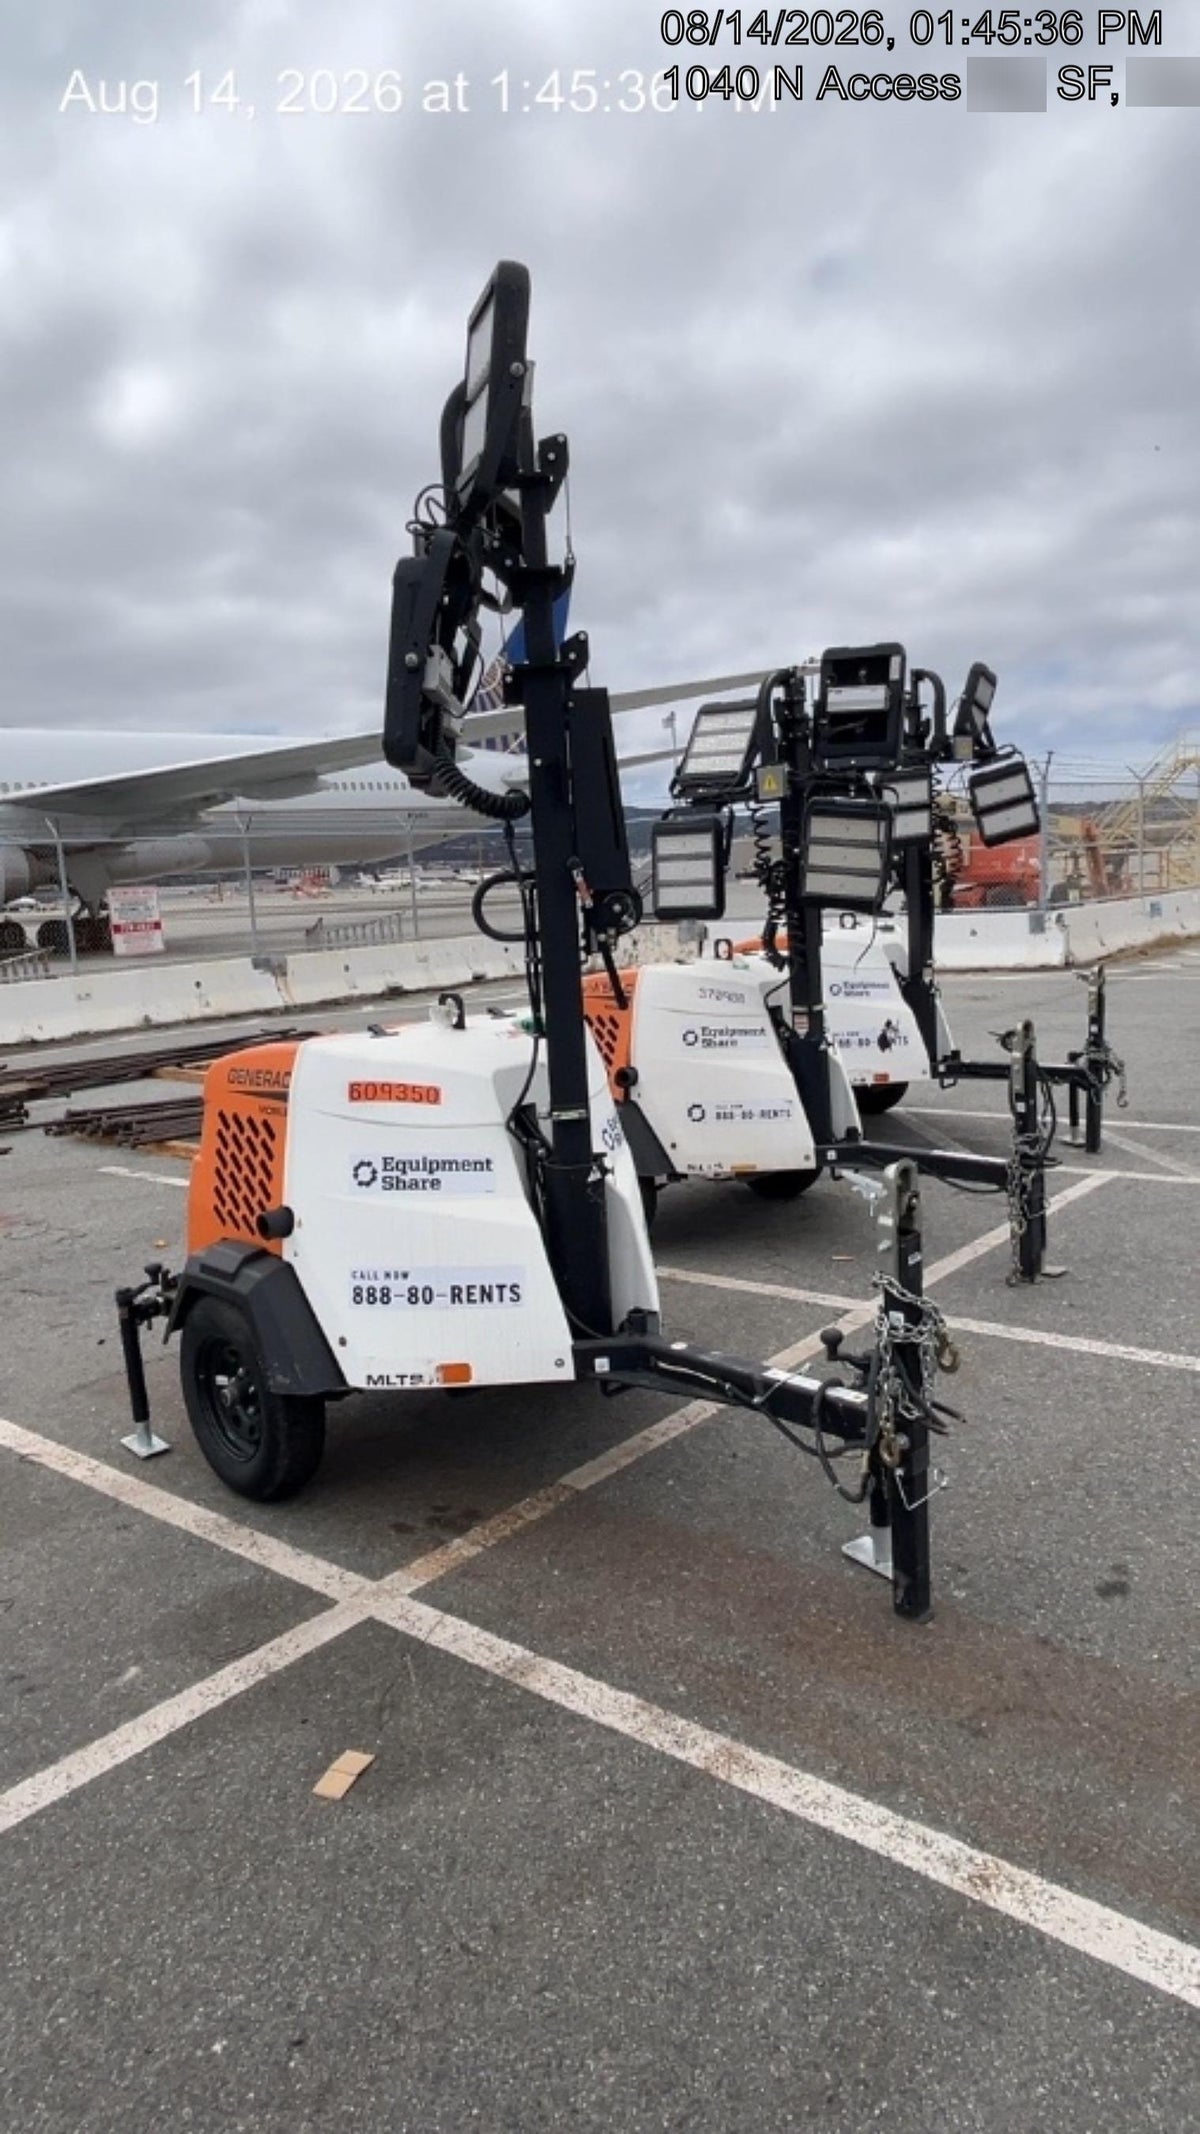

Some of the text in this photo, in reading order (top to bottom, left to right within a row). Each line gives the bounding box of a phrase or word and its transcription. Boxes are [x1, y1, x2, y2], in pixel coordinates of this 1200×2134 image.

[348, 1081, 441, 1104] 609350
[381, 1156, 493, 1175] Equipment
[381, 1175, 442, 1191] Share
[351, 1270, 410, 1281] CALL NOW
[351, 1283, 522, 1305] 888-80-RENTS
